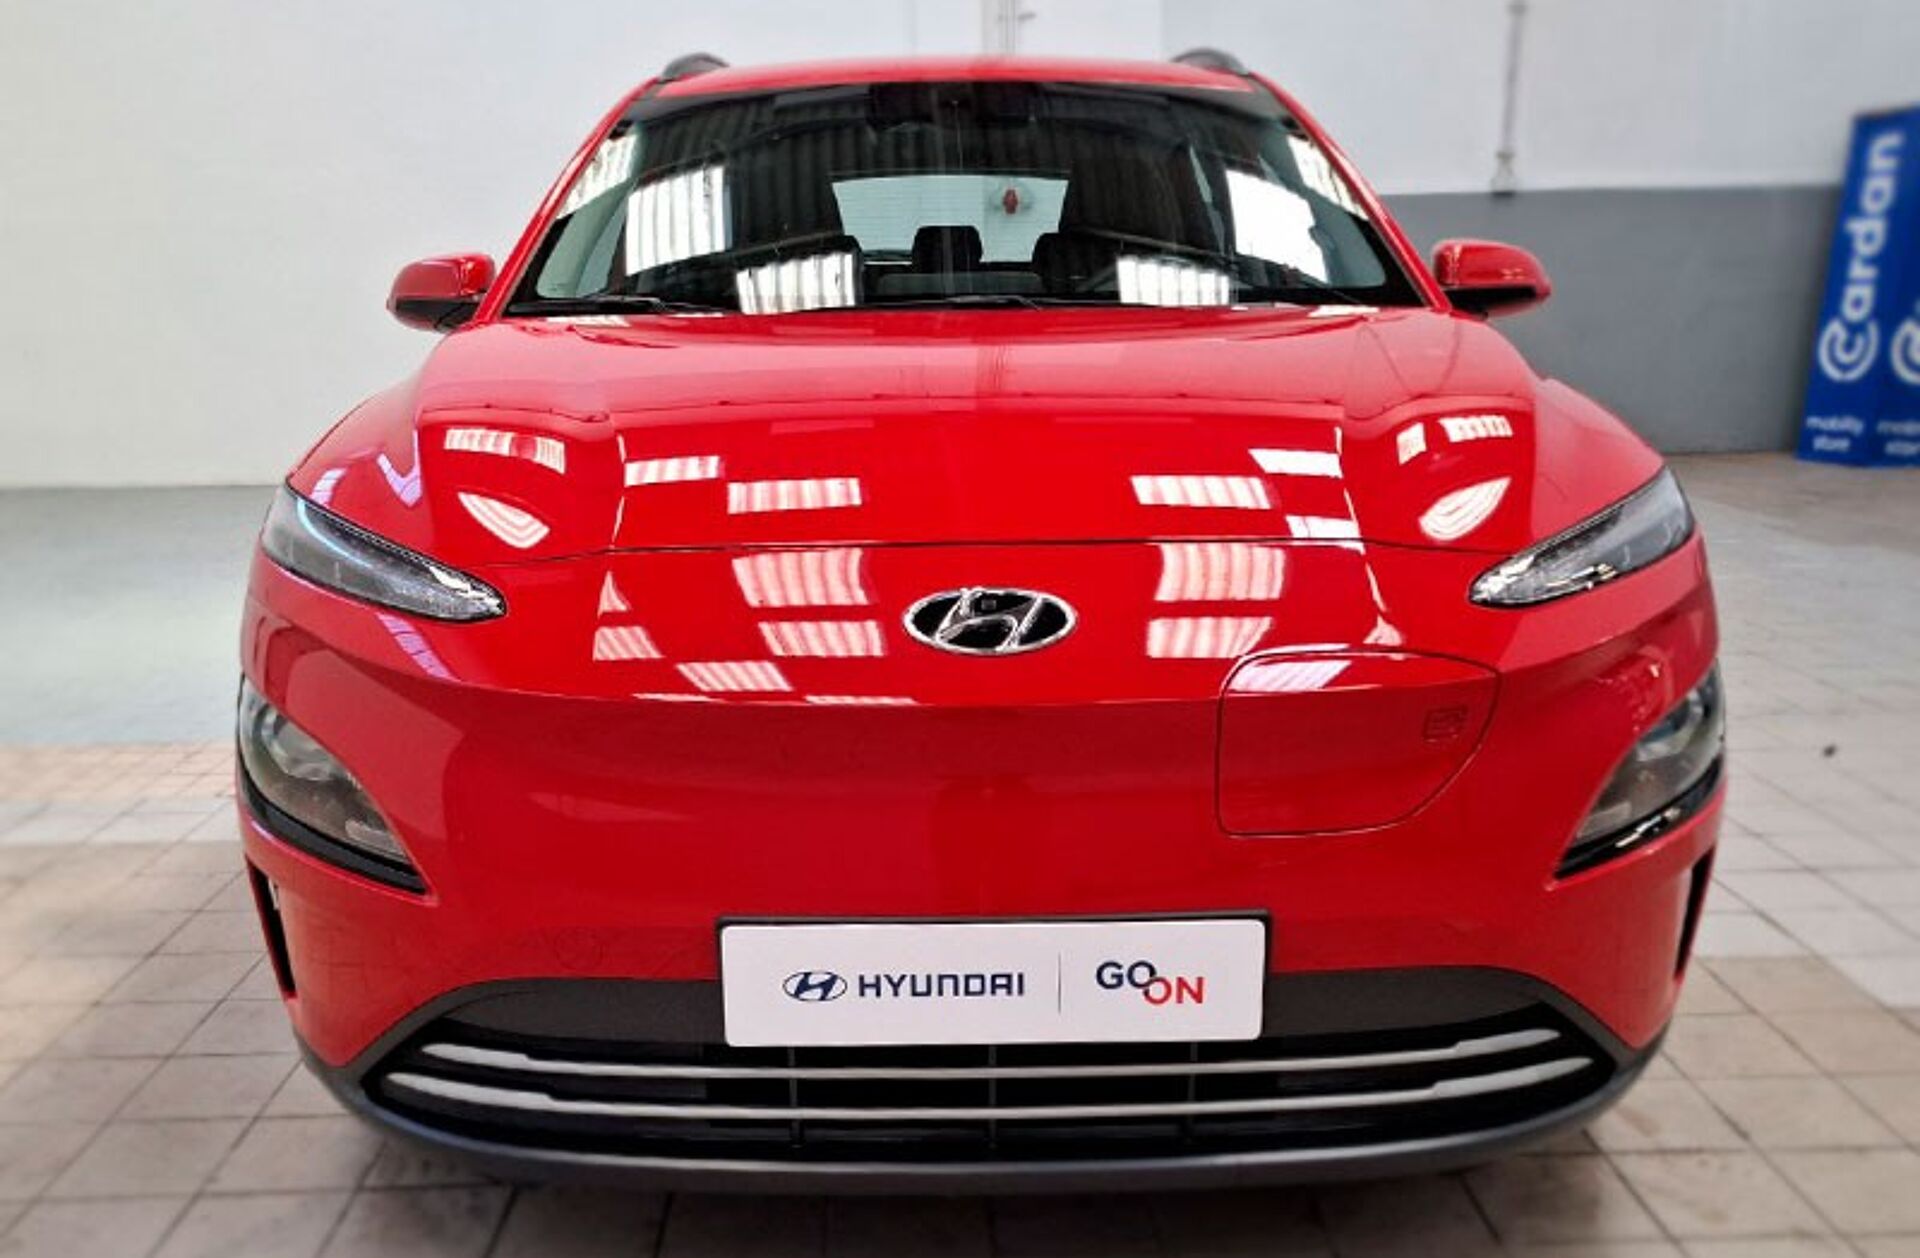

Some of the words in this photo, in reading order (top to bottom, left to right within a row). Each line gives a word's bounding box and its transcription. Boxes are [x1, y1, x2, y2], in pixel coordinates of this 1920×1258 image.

[1819, 130, 1903, 382] Cardan
[858, 972, 1024, 998] HYUNDAI
[1096, 960, 1157, 989] GO
[1143, 976, 1204, 1005] ON
